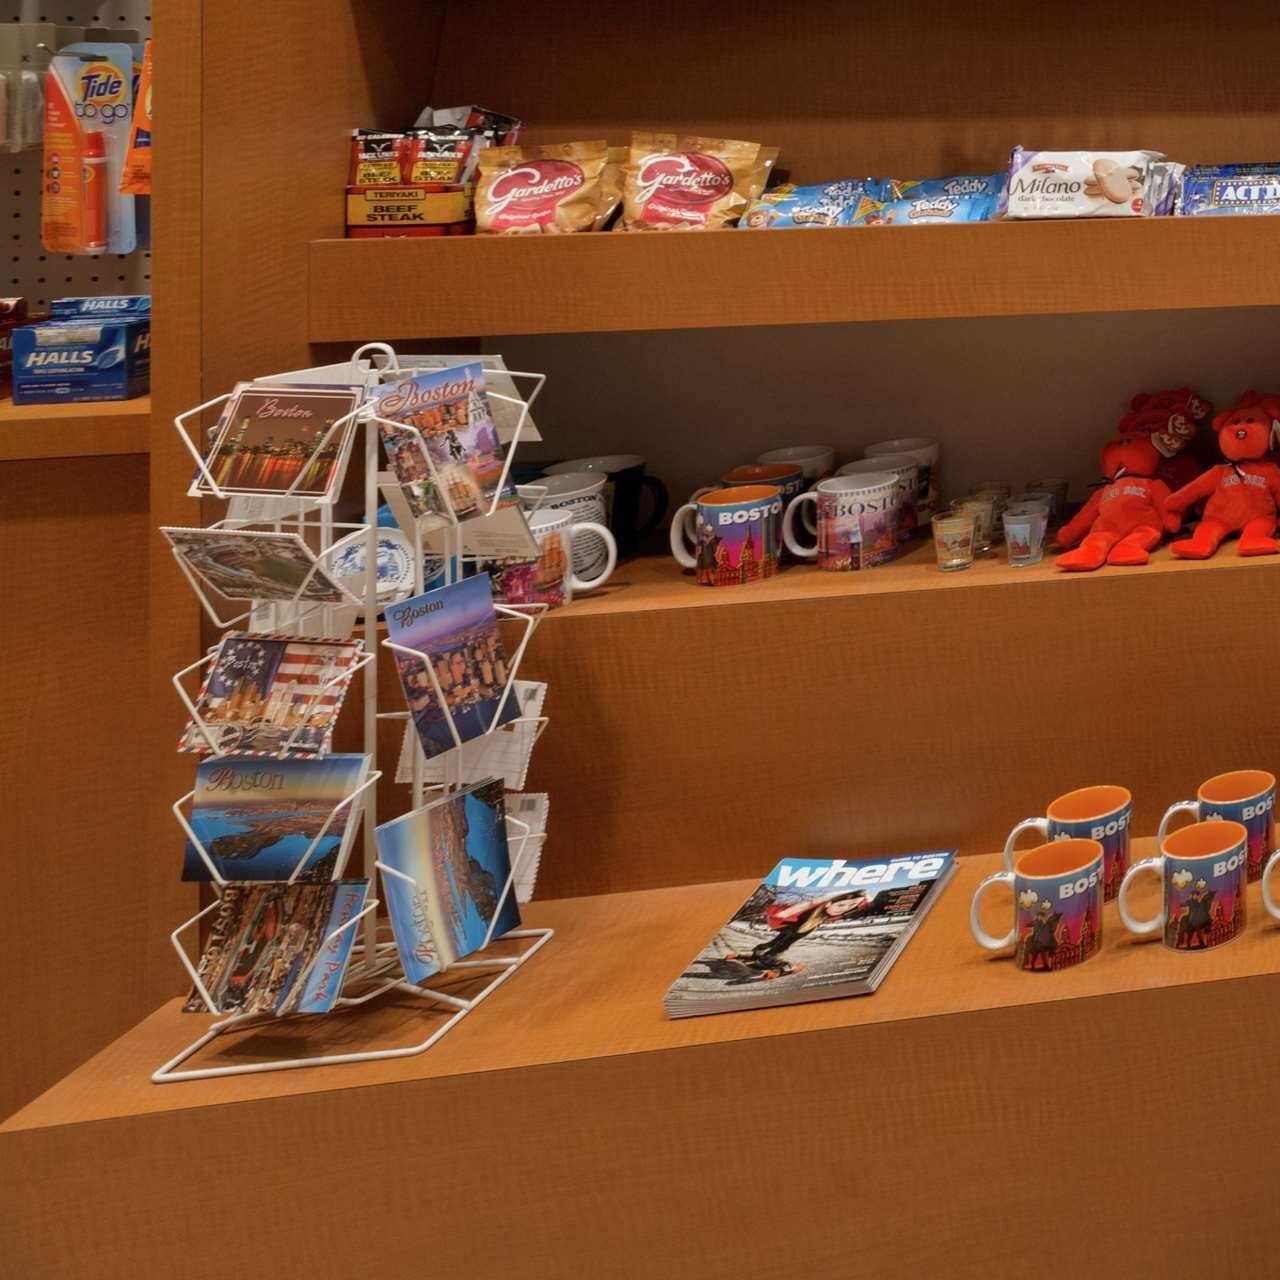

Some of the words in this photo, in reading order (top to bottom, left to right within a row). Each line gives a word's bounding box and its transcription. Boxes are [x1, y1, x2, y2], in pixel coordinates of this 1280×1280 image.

[81, 74, 122, 102] Tide
[75, 103, 98, 118] to
[100, 103, 130, 124] go
[634, 151, 732, 204] Gardetto's
[1009, 177, 1081, 195] Milano
[373, 191, 419, 199] TERIYAKI
[486, 168, 584, 215] Gardetto's
[945, 180, 987, 195] Teddy
[1221, 185, 1260, 201] ACT
[373, 205, 417, 213] BEEF
[914, 197, 958, 211] Teddy
[367, 213, 425, 222] STEAK
[82, 299, 129, 311] HALLS
[25, 351, 94, 368] HALLS
[378, 377, 478, 416] Boston
[255, 397, 313, 419] Boston
[551, 494, 599, 511] BOSTON
[391, 597, 444, 628] Boston
[204, 765, 285, 793] Boston
[777, 857, 945, 888] where
